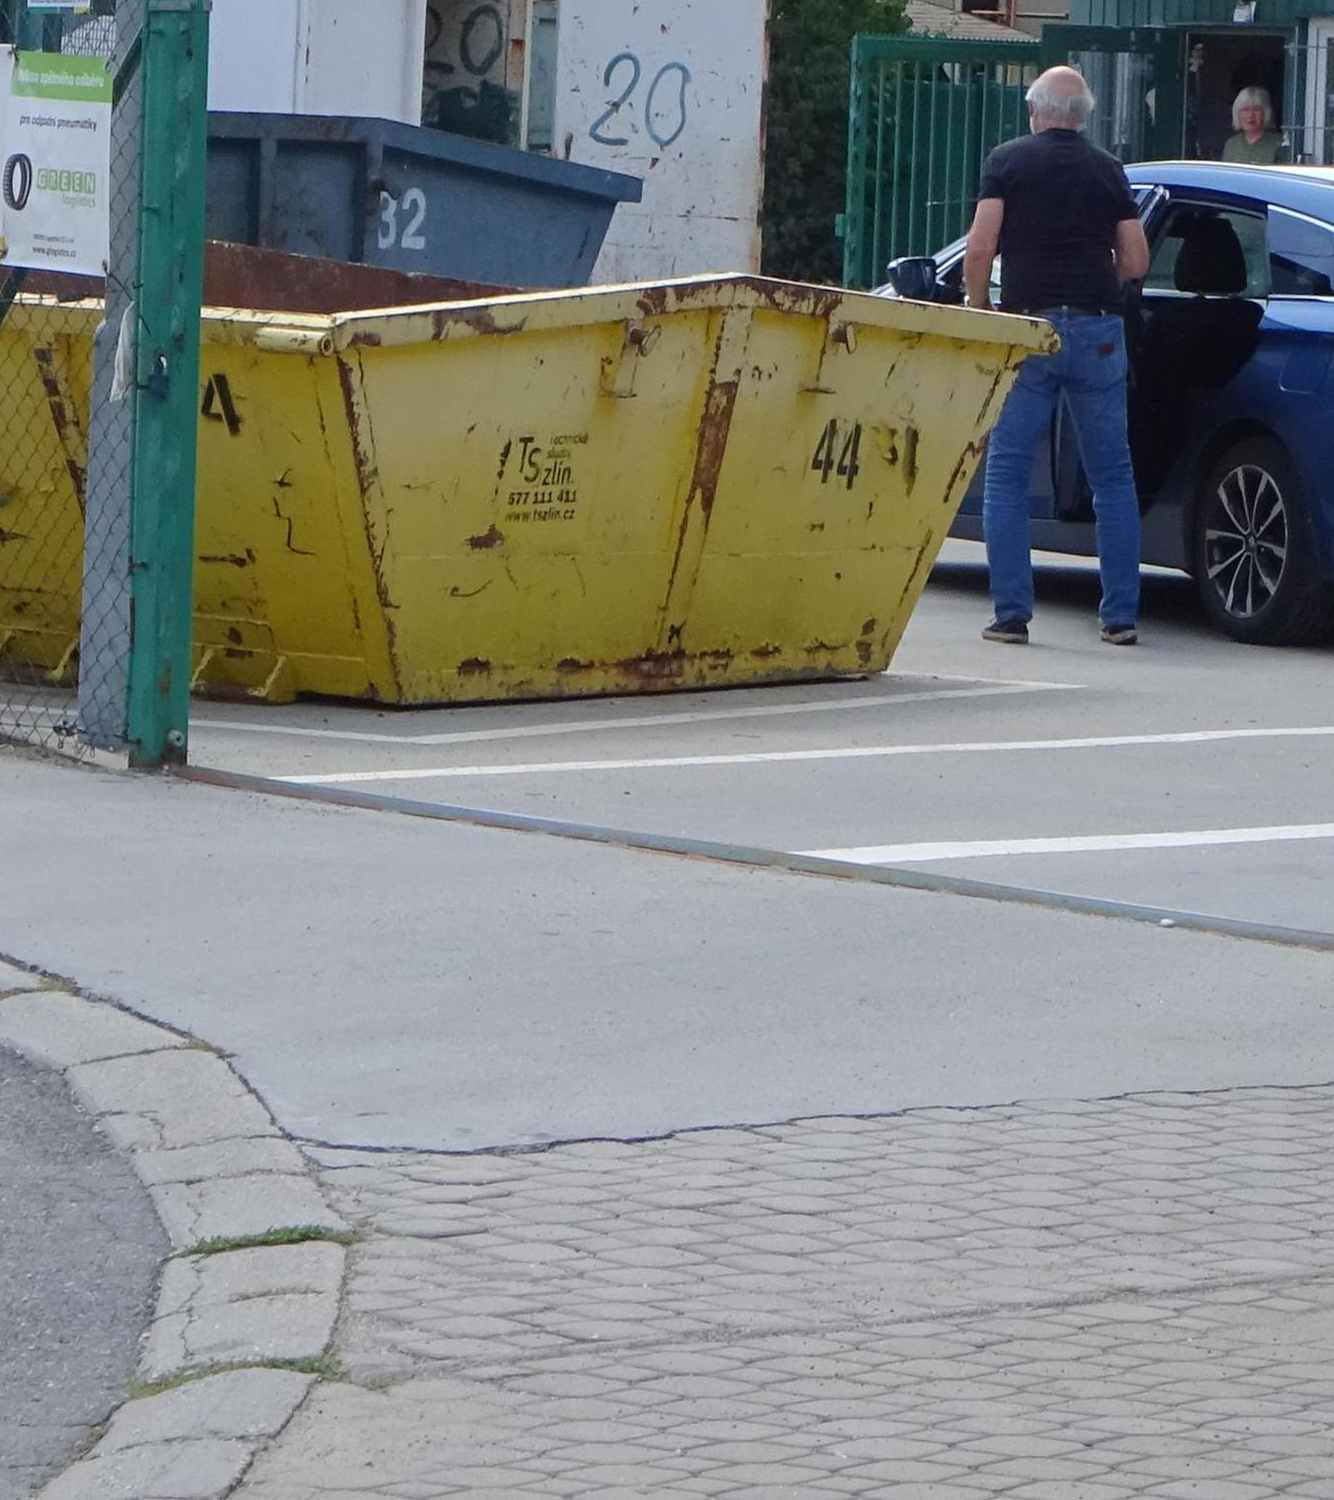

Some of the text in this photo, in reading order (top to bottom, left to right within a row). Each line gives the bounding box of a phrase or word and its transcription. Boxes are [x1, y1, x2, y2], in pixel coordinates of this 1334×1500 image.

[588, 49, 692, 148] 20
[36, 168, 96, 195] GREEN
[519, 436, 542, 483] TS
[811, 418, 862, 490] 44
[541, 460, 574, 486] zlín.
[508, 489, 577, 506] 577 111 411
